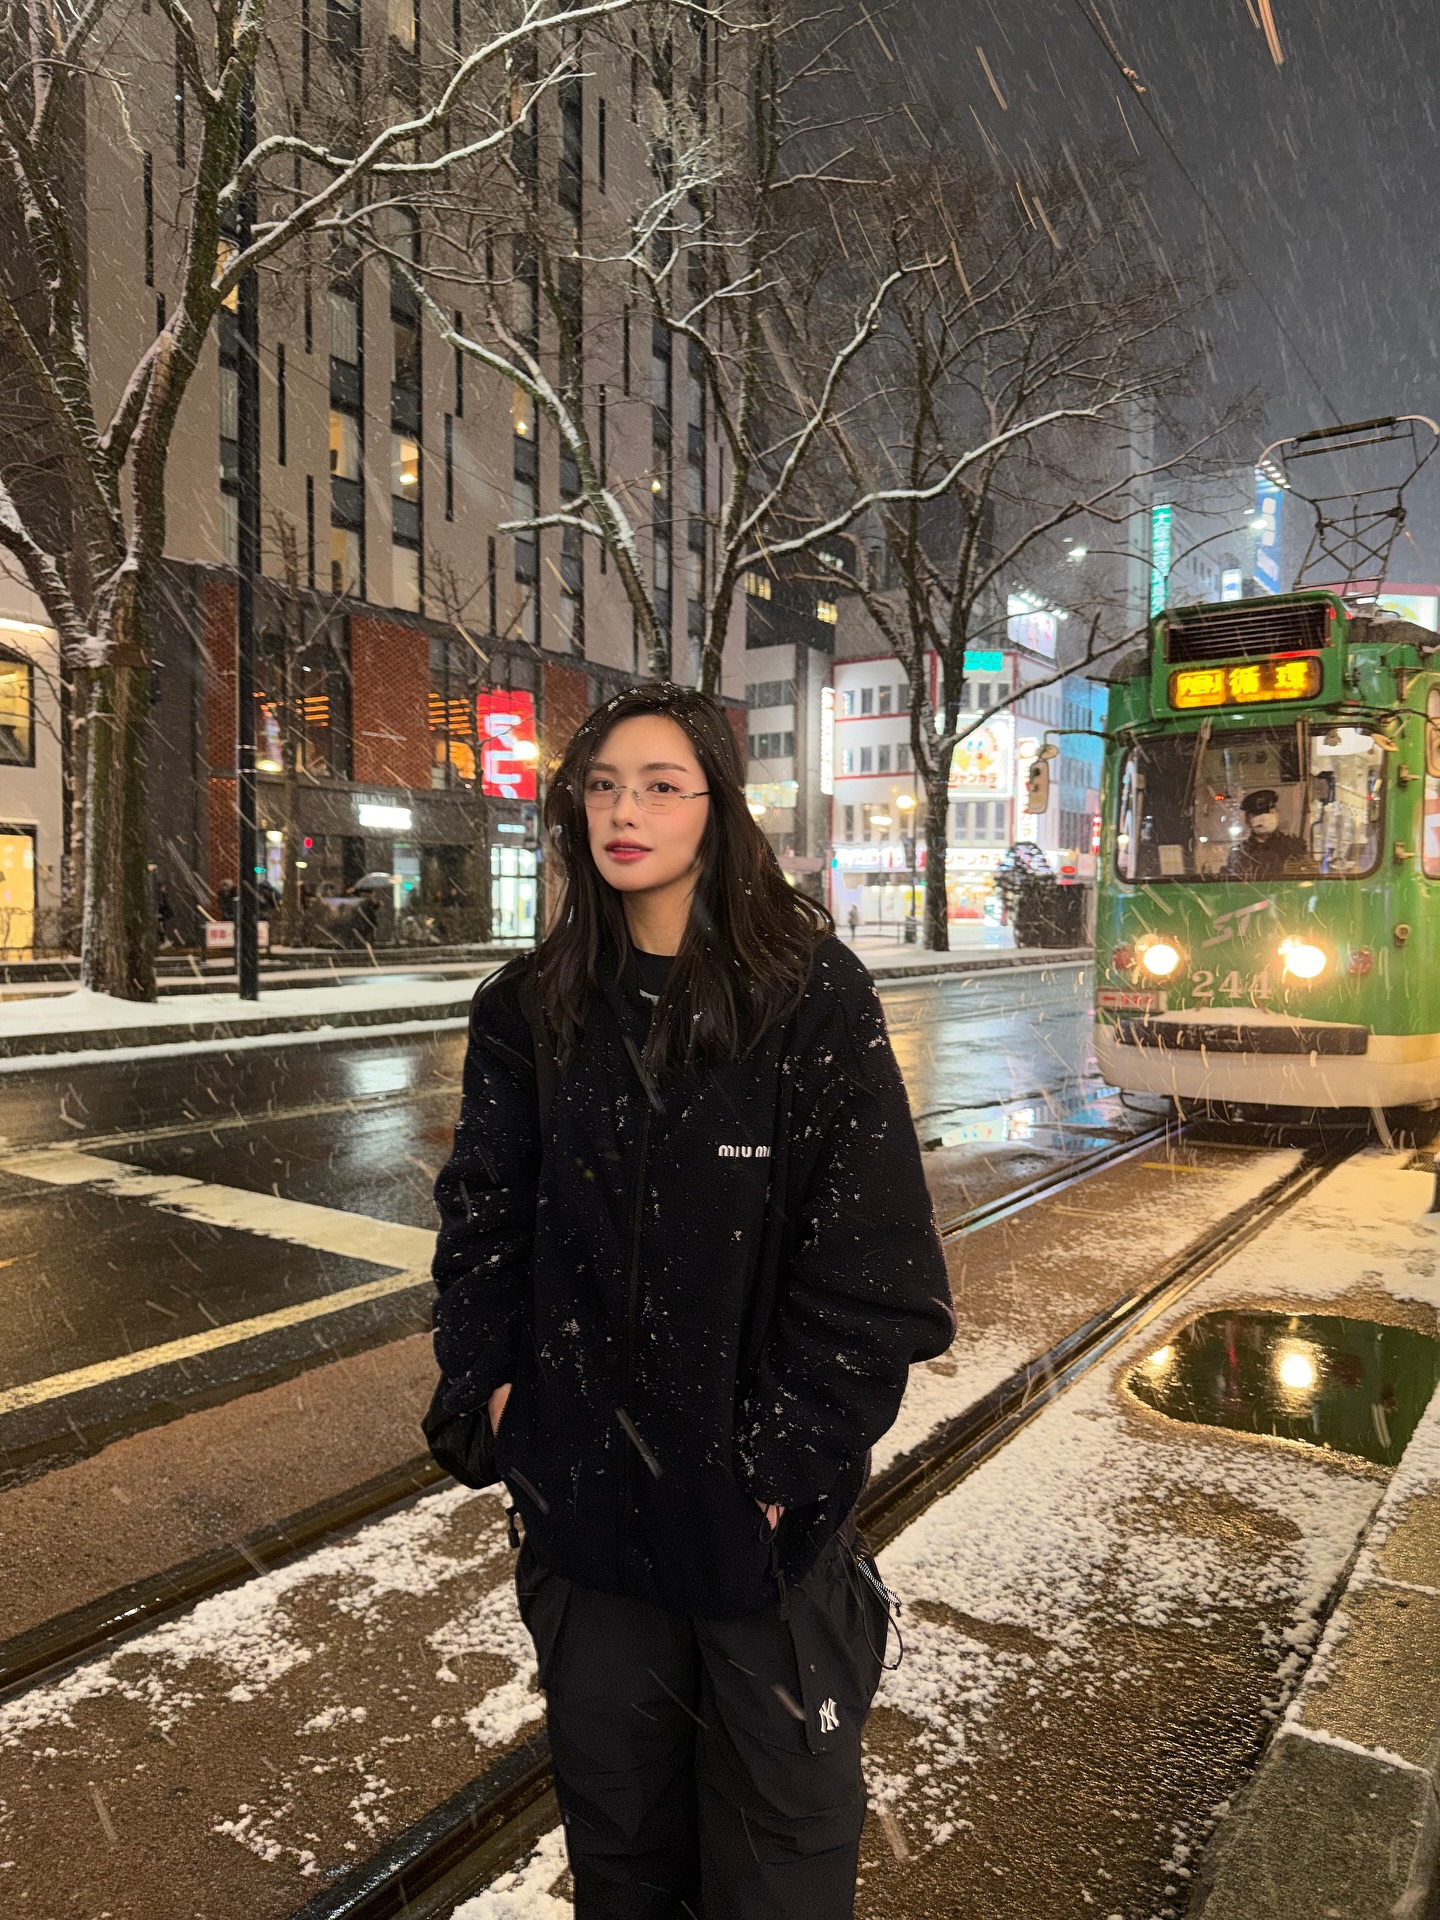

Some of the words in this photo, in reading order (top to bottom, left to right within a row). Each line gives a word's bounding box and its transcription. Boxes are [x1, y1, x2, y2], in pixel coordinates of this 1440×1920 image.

[1229, 662, 1308, 695] 循環
[948, 772, 997, 784] ジャンカラ
[1191, 970, 1272, 999] 244
[818, 1697, 840, 1734] NY
